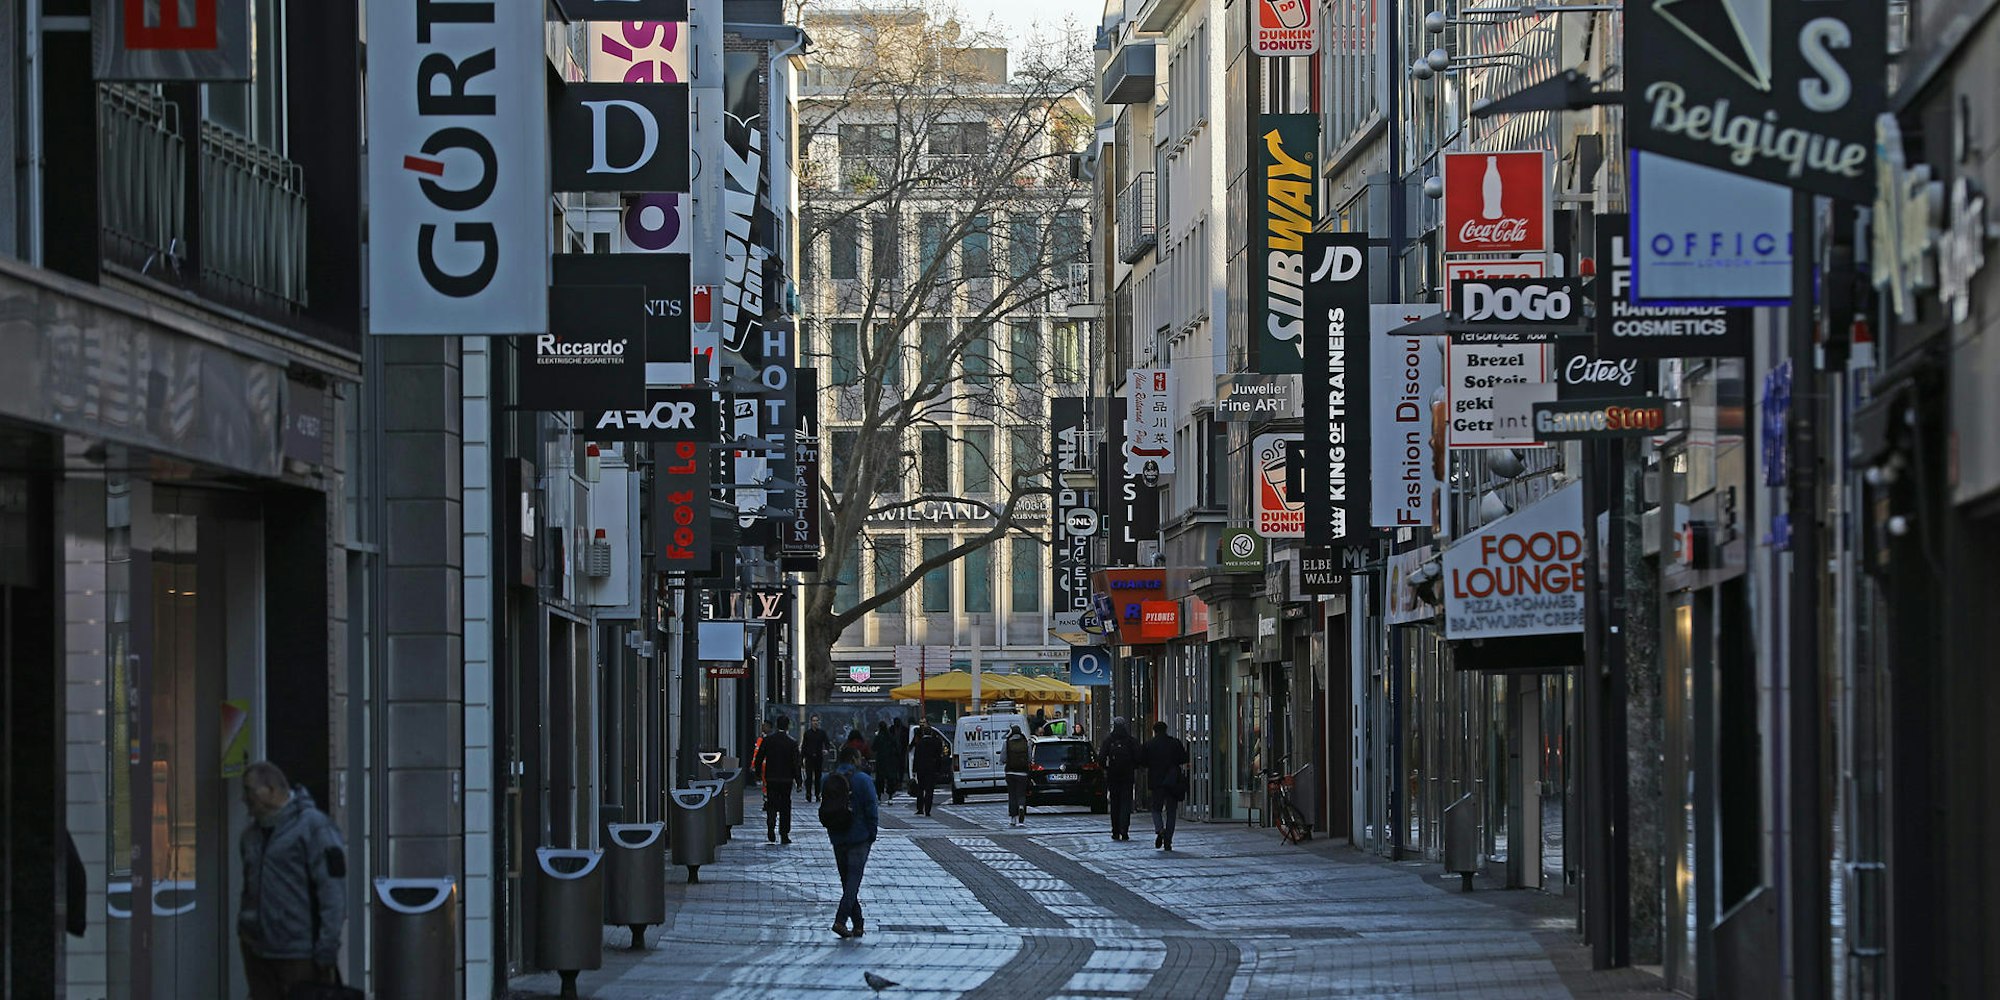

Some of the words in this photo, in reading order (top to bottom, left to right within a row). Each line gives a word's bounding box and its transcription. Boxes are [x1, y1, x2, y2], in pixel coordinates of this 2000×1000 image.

[1259, 30, 1315, 39] DUNKIN'
[1259, 41, 1312, 50] DONUTS
[1644, 81, 1867, 179] Belgique
[1264, 128, 1313, 359] SUBWAY
[1459, 217, 1529, 244] Coca-Cola
[1310, 246, 1363, 283] JD
[1612, 319, 1727, 337] COSMETICS
[536, 334, 625, 355] Riccardo
[1328, 307, 1345, 421] TRAINERS
[1396, 315, 1421, 423] Discout
[1467, 353, 1524, 367] Brezel
[1231, 383, 1288, 395] Juwelier
[1219, 399, 1251, 412] Fine
[1254, 399, 1287, 411] ART
[1536, 406, 1664, 433] GameStop
[1329, 423, 1345, 444] OF
[1329, 447, 1346, 501] KING
[1397, 431, 1420, 525] Fashion
[795, 465, 809, 542] FASHION
[667, 490, 695, 560] Foot
[1067, 517, 1096, 526] ONLY
[1481, 530, 1583, 566] FOOD
[1453, 563, 1585, 598] LOUNGE
[1145, 612, 1175, 622] PYLONES
[1464, 598, 1504, 614] PIZZA
[1512, 595, 1577, 612] POMMES
[1450, 613, 1537, 633] BRATWURST
